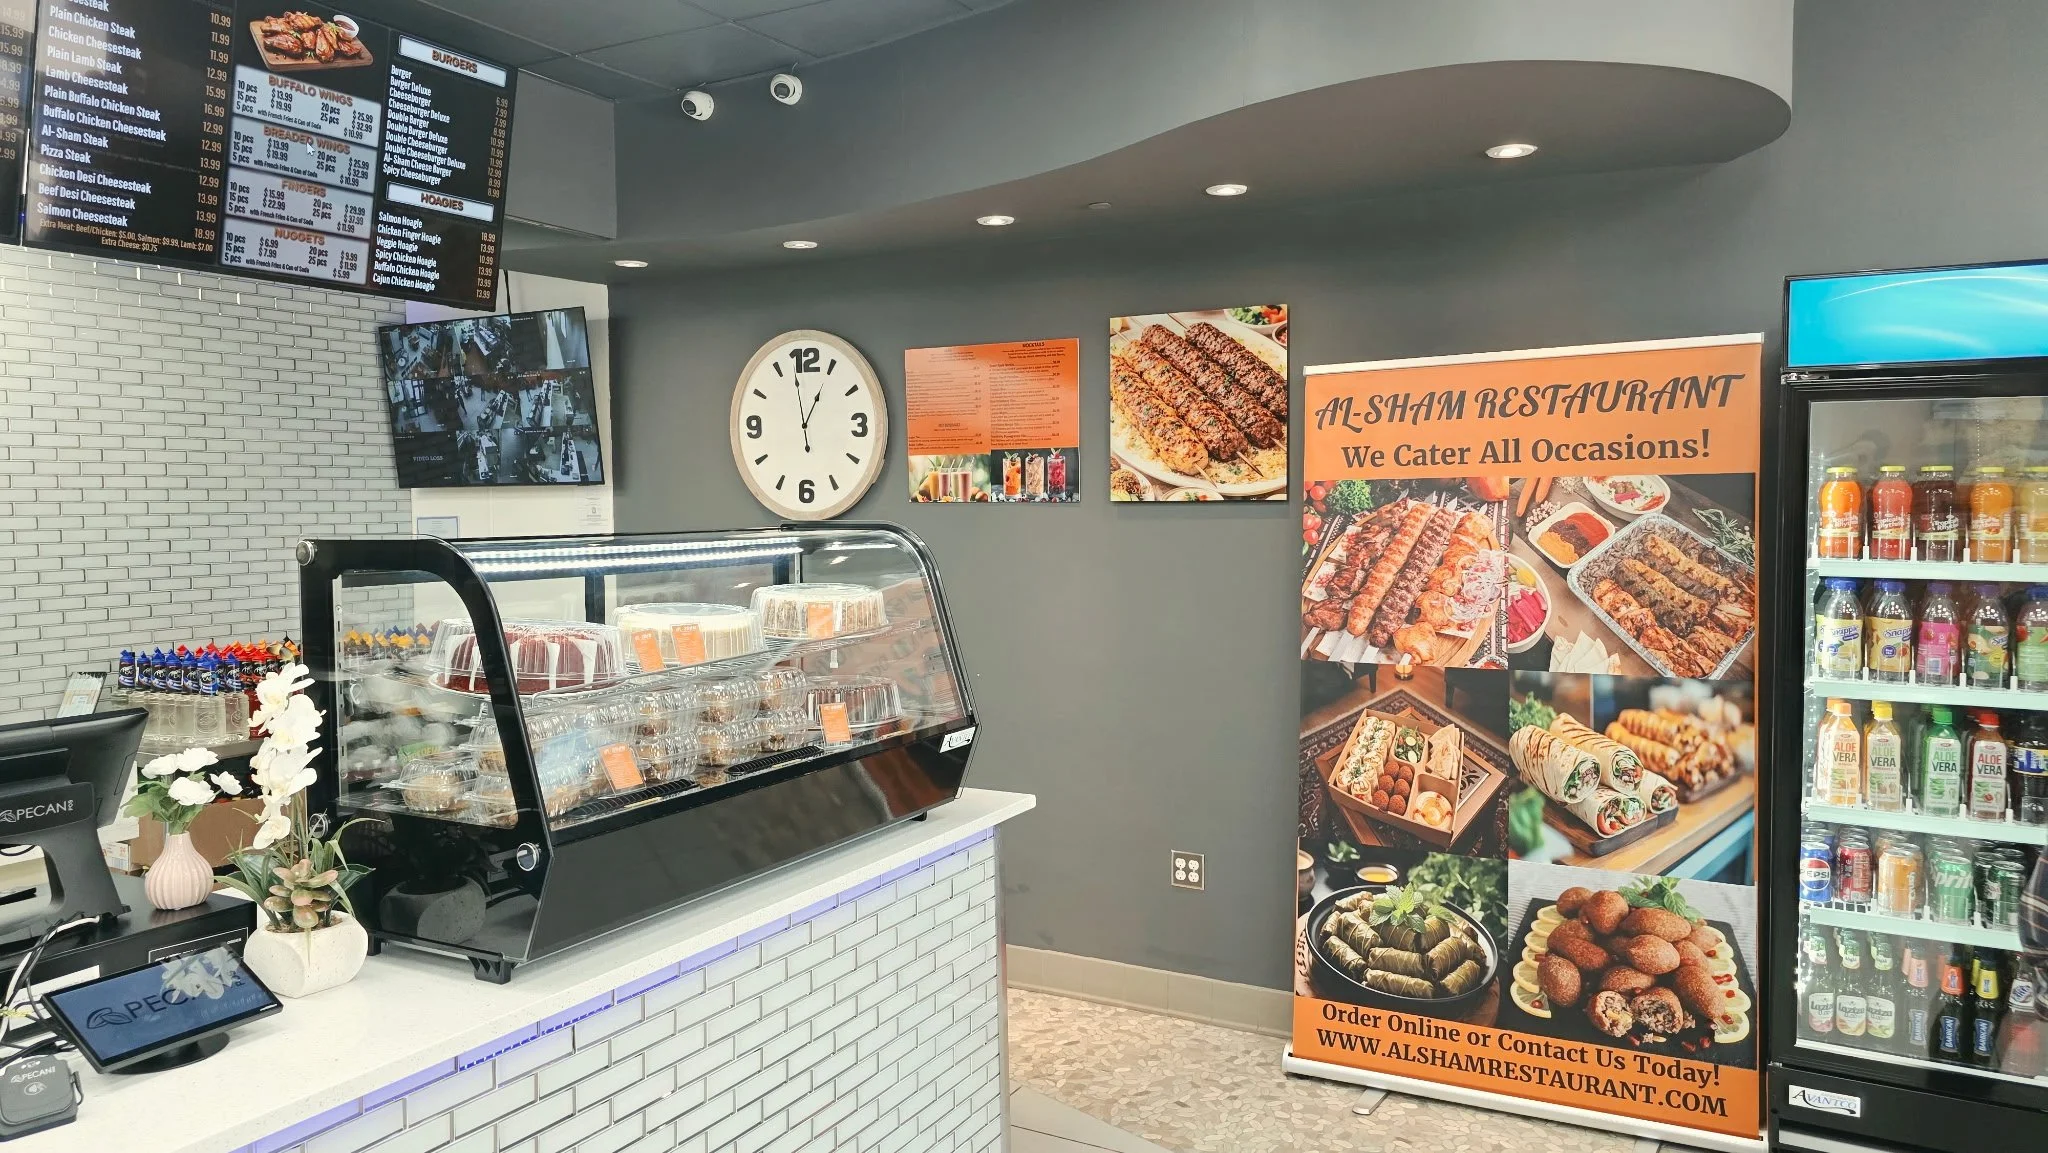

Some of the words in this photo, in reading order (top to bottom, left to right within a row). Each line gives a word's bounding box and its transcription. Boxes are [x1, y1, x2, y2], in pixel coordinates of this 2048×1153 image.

[50, 5, 72, 22] Plain
[74, 12, 109, 31] Chicken
[111, 22, 136, 39] Steak
[210, 12, 231, 28] 10.99
[49, 25, 84, 45] Chicken
[86, 35, 142, 60] Cheesesteak
[211, 31, 230, 46] 11.99
[47, 45, 70, 61] Plain
[72, 51, 96, 67] Lamb
[97, 58, 122, 74] Steak
[210, 50, 229, 64] 11.99
[432, 49, 478, 74] BURGERS
[46, 65, 70, 81] Lamb
[72, 71, 129, 95] Cheesesteak
[206, 67, 227, 82] 12.99
[391, 64, 412, 80] Burger
[205, 85, 226, 100] 15.99
[268, 74, 317, 97] BUFFALO
[319, 88, 353, 108] WINGS
[389, 87, 431, 107] Cheeseburger
[390, 76, 411, 90] Burger
[411, 82, 432, 97] Deluxe
[44, 85, 67, 100] Plain
[69, 90, 100, 108] Buffalo
[101, 97, 135, 115] Chicken
[136, 107, 161, 122] Steak
[204, 103, 225, 118] 16.99
[388, 98, 430, 118] Cheeseburger
[430, 109, 451, 124] Deluxe
[43, 104, 76, 122] Buffalo
[77, 111, 112, 129] Chicken
[112, 120, 167, 142] Cheesesteak
[202, 121, 224, 136] 12.99
[387, 108, 408, 122] Double
[409, 114, 430, 129] Burger
[56, 127, 82, 143] Sham
[83, 134, 109, 148] Steak
[263, 124, 315, 145] BREADED
[316, 137, 350, 156] WINGS
[386, 119, 408, 134] Double
[408, 126, 428, 140] Burger
[428, 131, 449, 145] Deluxe
[40, 143, 64, 159] Pizza
[66, 149, 91, 164] Steak
[201, 139, 222, 153] 12.99
[386, 130, 407, 145] Double
[407, 136, 448, 156] Cheeseburger
[200, 157, 221, 171] 13.99
[384, 141, 406, 156] Double
[406, 147, 447, 166] Cheeseburger
[446, 157, 466, 170] Deluxe
[393, 154, 410, 168] Sham
[410, 158, 432, 172] Cheese
[432, 164, 452, 178] Burger
[40, 163, 76, 180] Chicken
[77, 170, 96, 184] Desi
[97, 174, 152, 194] Cheesesteak
[199, 175, 220, 189] 12.99
[382, 163, 400, 178] Spicy
[400, 167, 442, 186] Cheeseburger
[38, 182, 60, 198] Beef
[60, 186, 80, 201] Desi
[80, 190, 136, 210] Cheesesteak
[197, 192, 218, 206] 13.99
[281, 179, 327, 198] FINGERS
[420, 192, 465, 212] HOAGIES
[37, 202, 71, 218] Salmon
[72, 208, 128, 228] Cheesesteak
[196, 210, 216, 224] 13.99
[378, 211, 402, 225] Salmon
[402, 215, 423, 230] Hoagie
[39, 219, 58, 230] Extra
[59, 222, 75, 232] Meat:
[76, 224, 118, 240] Beef/Chicken:
[138, 234, 162, 246] Salmon:
[180, 240, 197, 251] Lamb:
[198, 242, 214, 253] $7.00
[101, 236, 118, 248] Extra
[118, 239, 141, 251] Cheese:
[142, 242, 158, 253] $0.75
[194, 228, 216, 242] 18.99
[274, 227, 326, 246] NUGGETS
[376, 236, 397, 250] Veggie
[397, 240, 419, 254] Hoagie
[377, 224, 402, 237] Chicken
[402, 229, 421, 242] Finger
[421, 232, 442, 246] Hoagie
[375, 248, 392, 262] Spicy
[392, 252, 416, 266] Chicken
[416, 255, 437, 269] Hoagie
[374, 260, 396, 274] Buffalo
[396, 264, 420, 277] Chicken
[420, 267, 440, 282] Hoagie
[372, 272, 391, 286] Cajun
[391, 276, 415, 289] Chicken
[414, 279, 436, 293] Hoagie
[789, 347, 821, 374] 12
[1314, 389, 1467, 434] AL-SHAM
[1473, 373, 1746, 420] RESTAURANT
[745, 414, 763, 439] 9
[850, 412, 869, 438] 3
[1341, 444, 1385, 469] We
[1393, 442, 1472, 468] Cater
[1478, 438, 1521, 464] All
[1530, 428, 1711, 464] Occasions!
[798, 478, 816, 504] 6
[1832, 752, 1857, 762] VERA
[1833, 742, 1857, 752] ALOE
[1872, 746, 1896, 757] ALOE
[1933, 750, 1958, 762] ALOE
[1870, 756, 1896, 768] VERA
[1932, 762, 1958, 773] VERA
[1977, 753, 2003, 765] ALOE
[1976, 764, 2003, 776] VERA
[16, 800, 67, 821] PECAN
[1321, 1002, 1381, 1030] Order
[1387, 1013, 1461, 1043] Online
[1466, 1030, 1492, 1048] or
[1497, 1032, 1589, 1066] Contact
[1595, 1046, 1628, 1072] Us
[1633, 1054, 1721, 1088] Today!
[22, 1067, 52, 1080] PECAN
[1315, 1028, 1729, 1117] WWW.ALSHAMRESTAURANT.COM
[1792, 1089, 1857, 1112] AVANTCO
